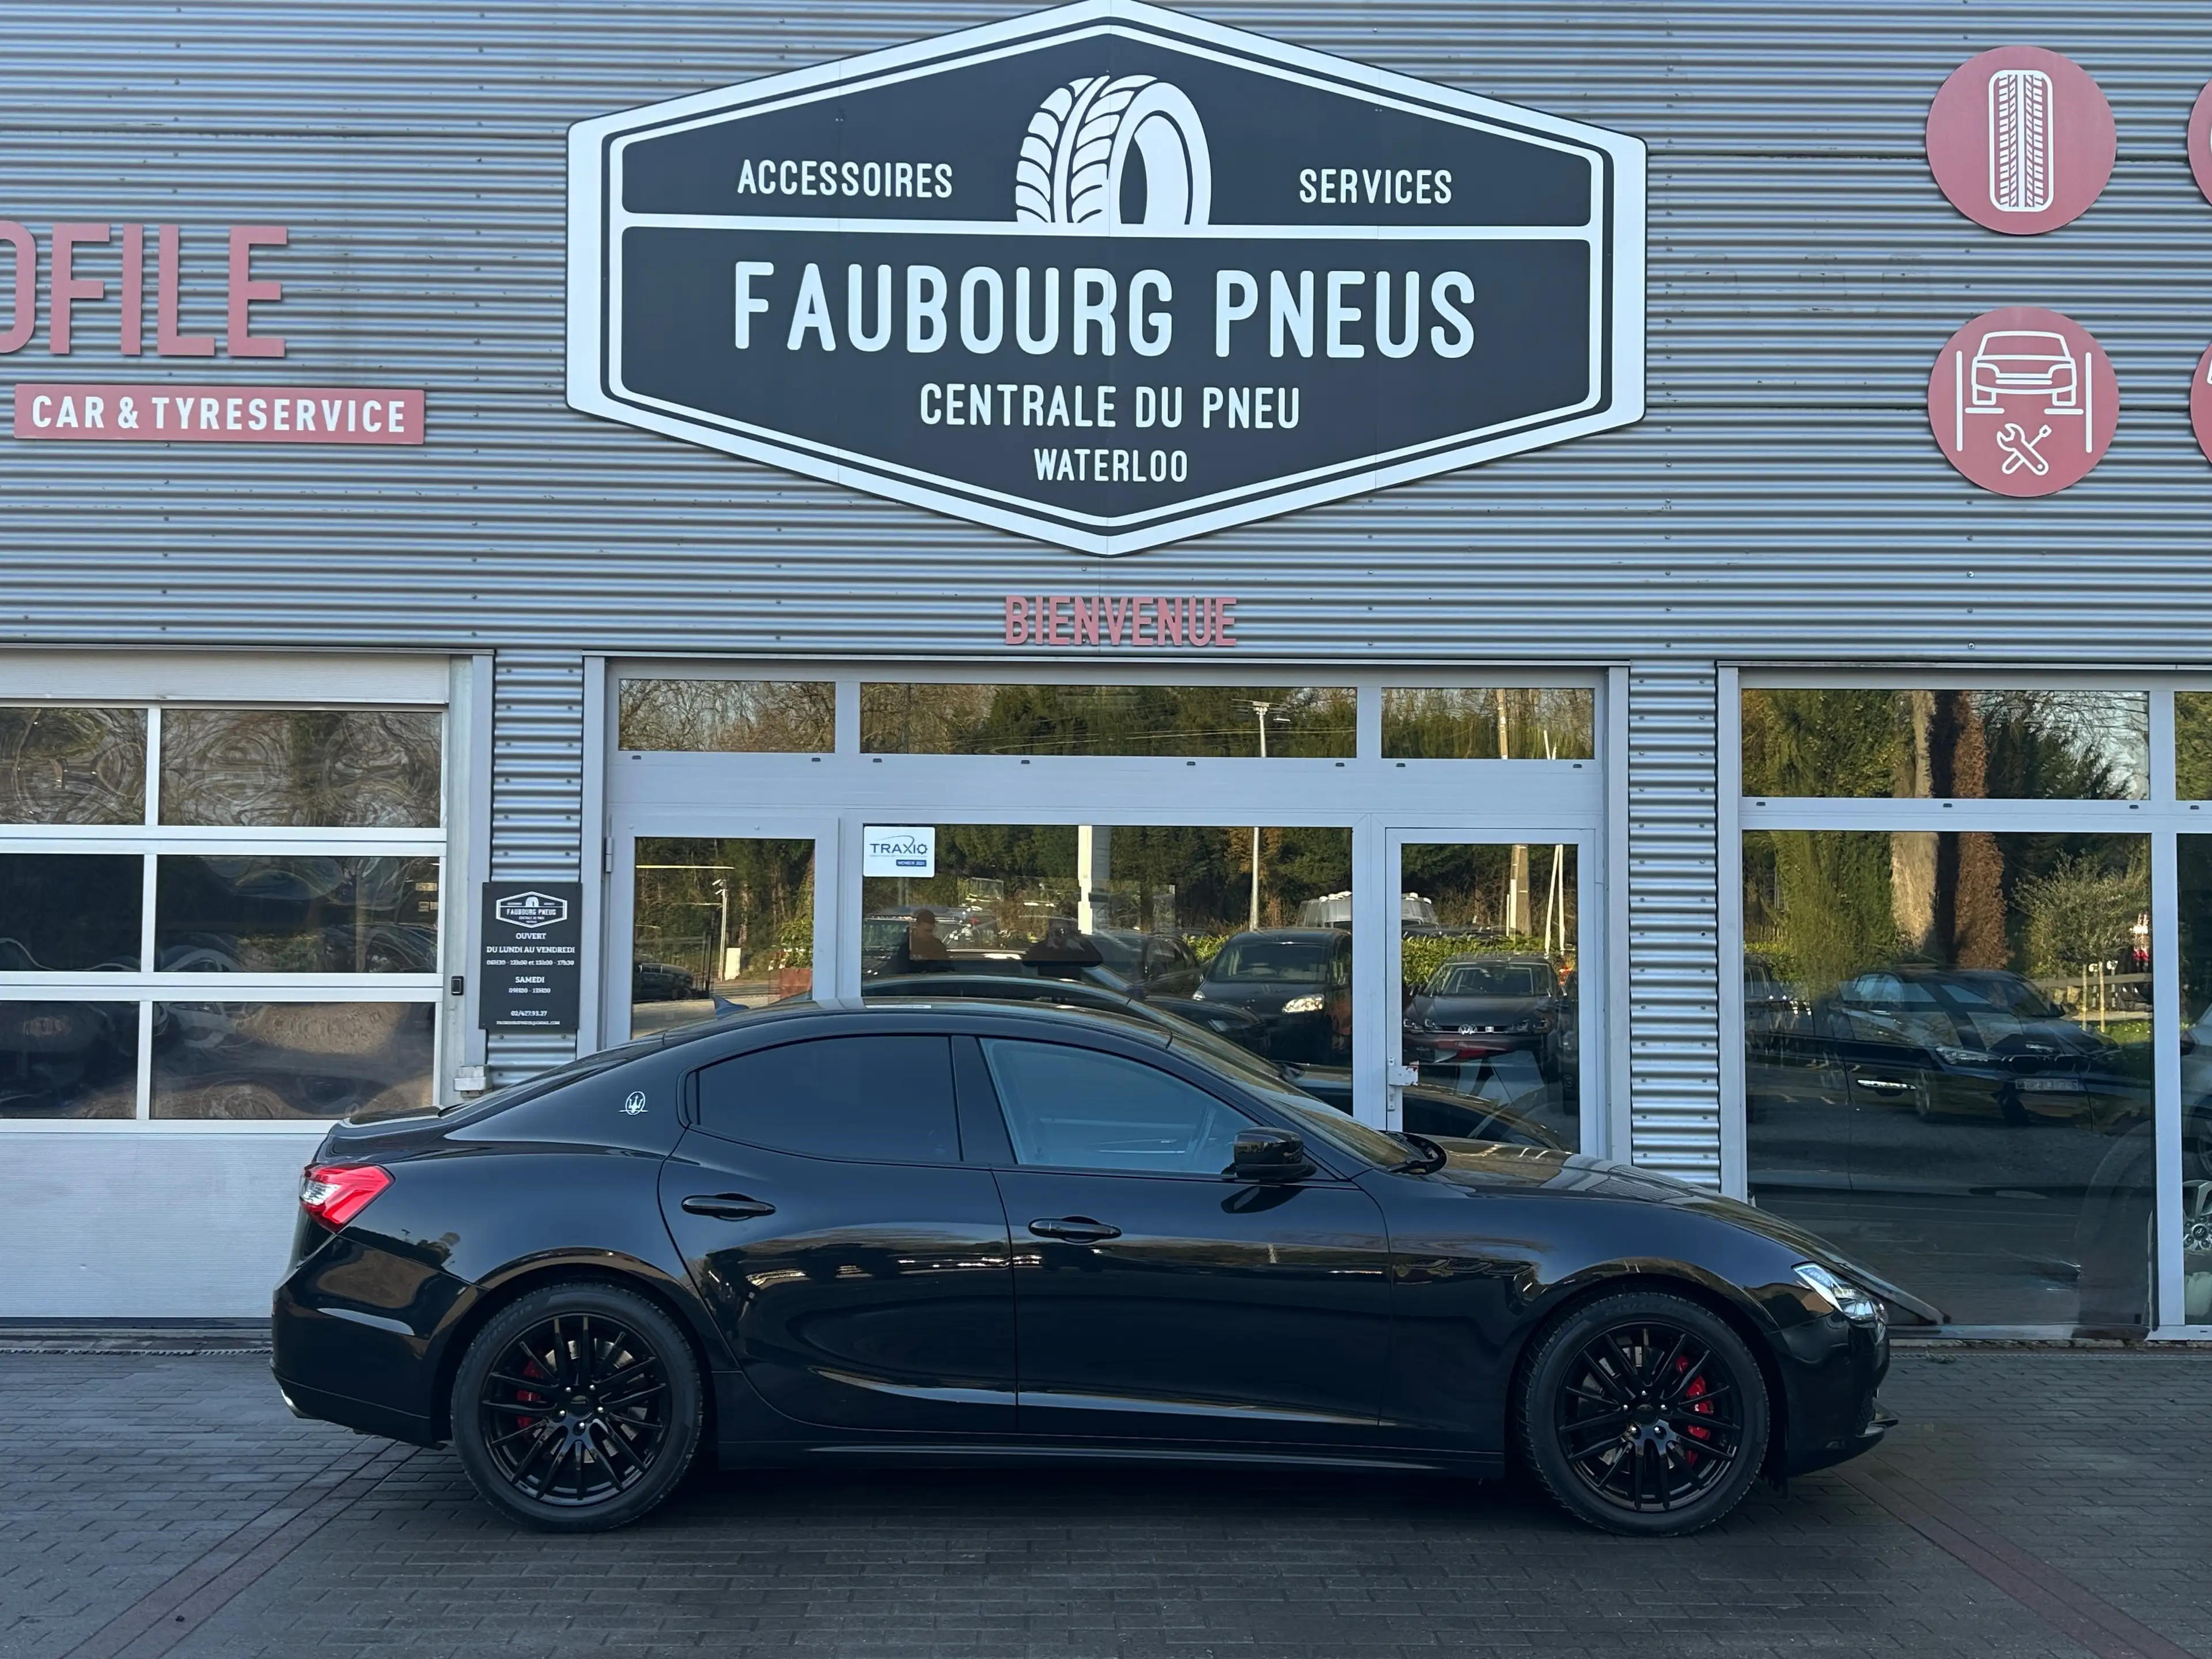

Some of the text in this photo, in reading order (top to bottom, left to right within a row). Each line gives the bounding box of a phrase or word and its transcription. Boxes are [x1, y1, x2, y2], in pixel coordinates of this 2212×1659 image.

[737, 159, 952, 198] ACCESSOIRES
[1300, 168, 1452, 206] SERVICES
[734, 261, 1475, 359] FAUBOURG PNEUS
[32, 395, 405, 433] CAR & TYRESERVICE
[920, 383, 1300, 429] CENTRALE DU PNEU
[1033, 448, 1188, 482] WATERLOO
[1004, 594, 1237, 647] BIENVENUE
[869, 843, 928, 855] TRAXIO
[516, 932, 547, 940] OUVERT
[536, 946, 575, 954] VENDREDI
